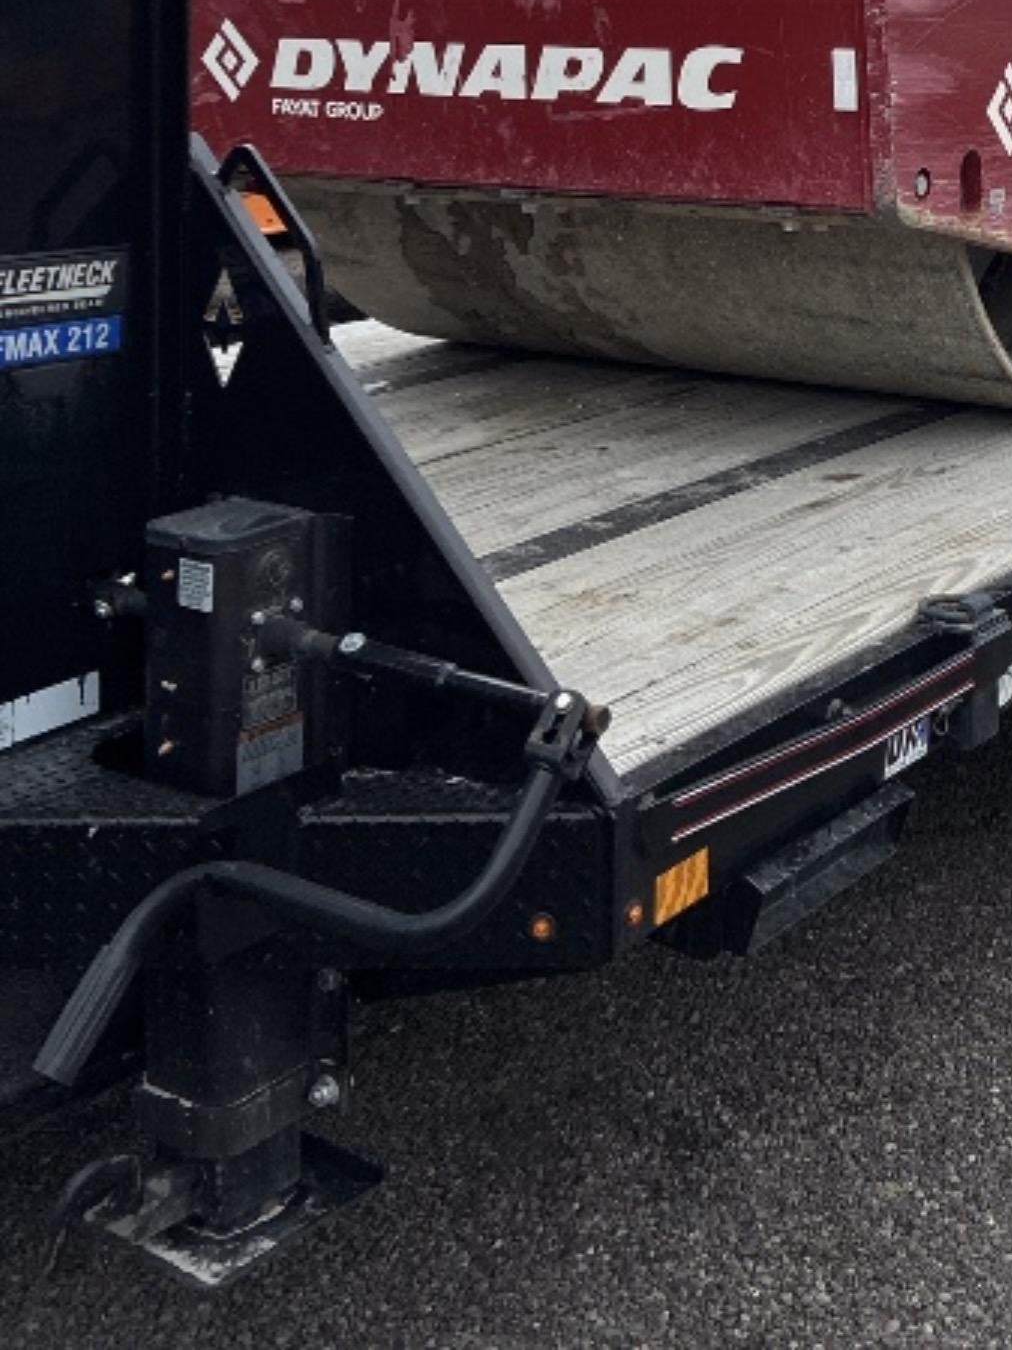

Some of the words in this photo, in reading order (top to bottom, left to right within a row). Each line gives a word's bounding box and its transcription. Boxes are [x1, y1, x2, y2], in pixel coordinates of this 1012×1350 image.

[270, 38, 744, 110] DYNAPAC
[272, 98, 320, 119] FAYAT
[326, 101, 384, 121] GROUP
[67, 323, 109, 352] 212
